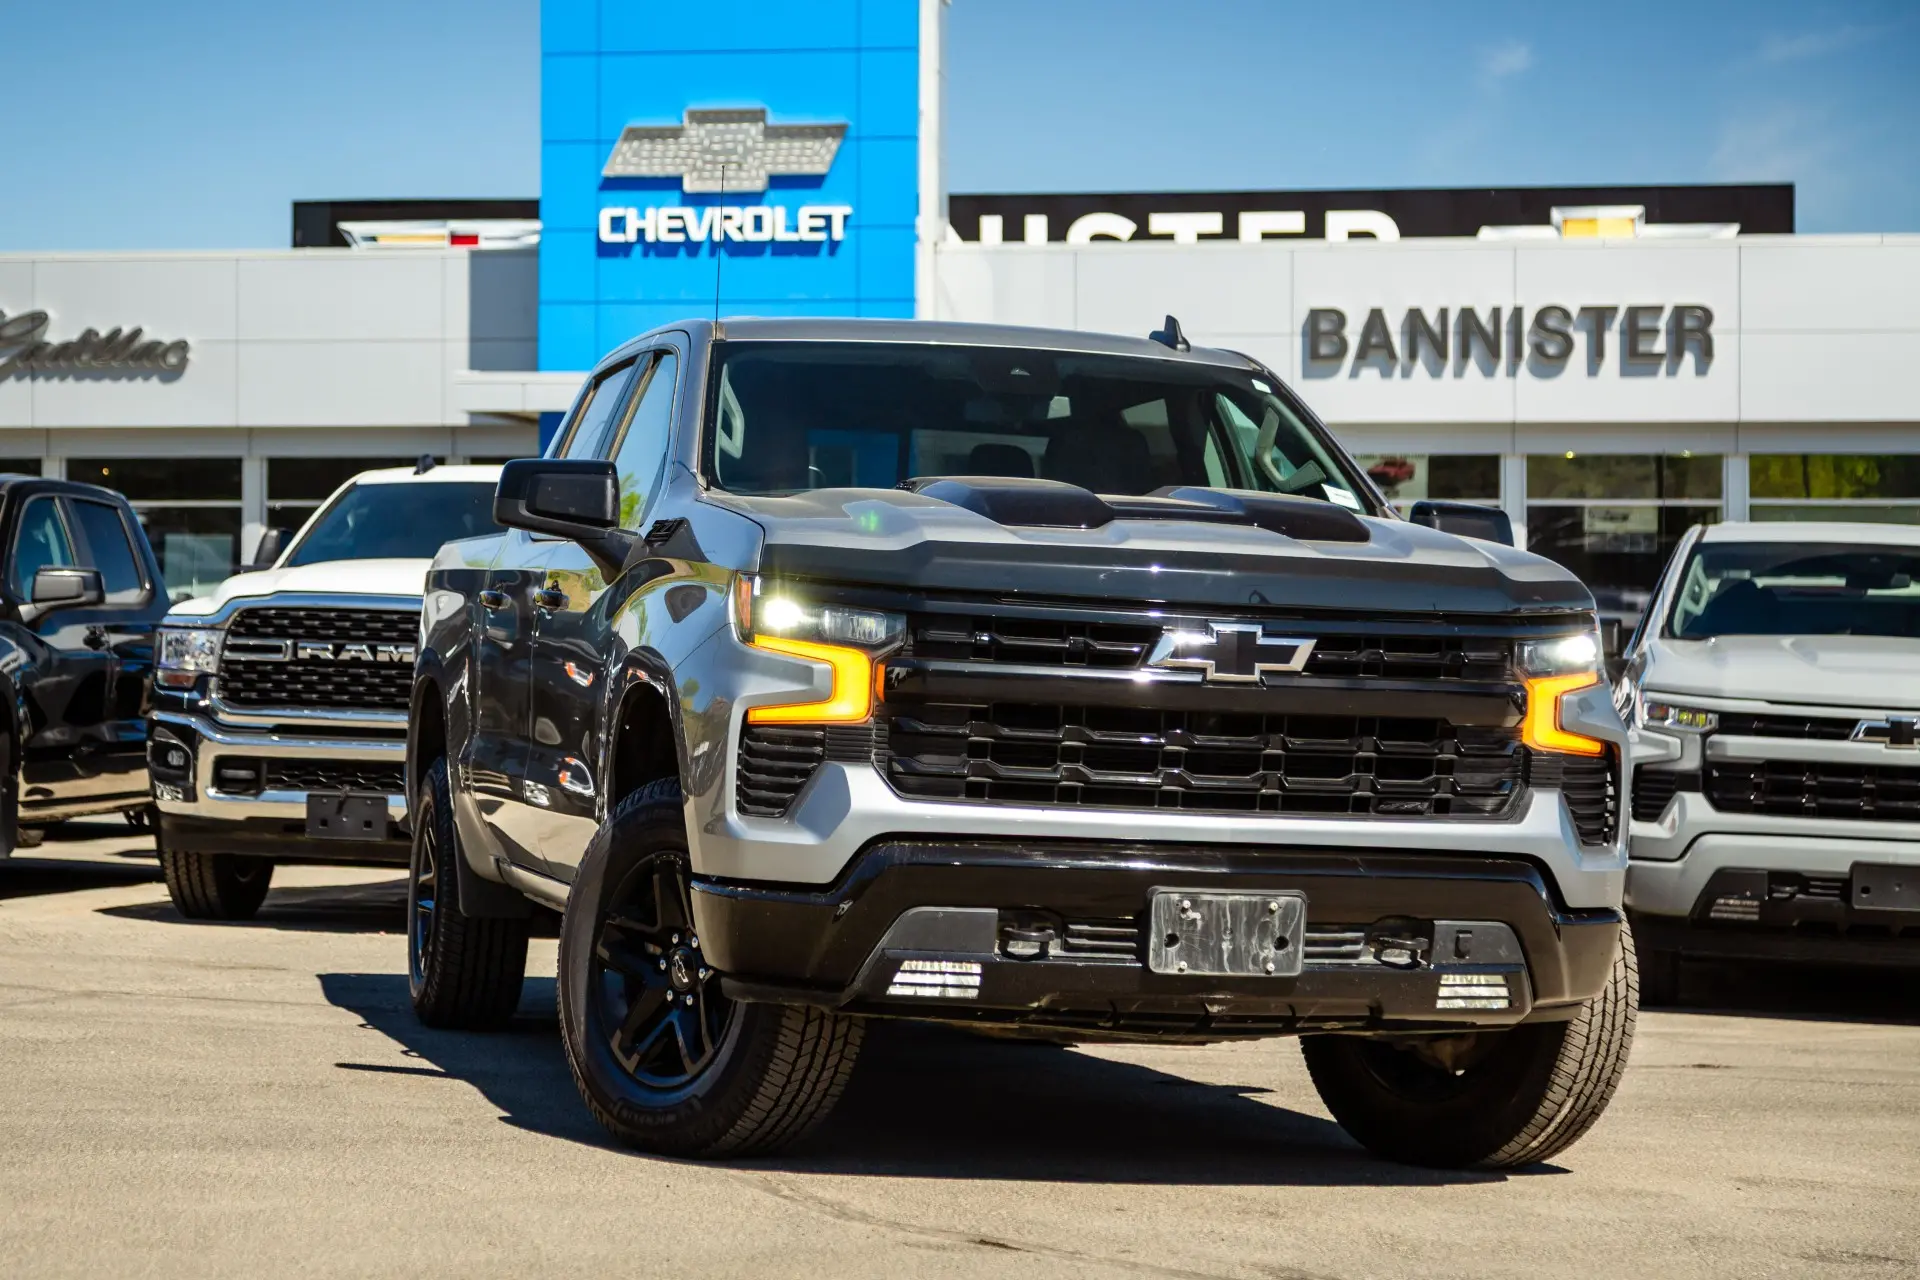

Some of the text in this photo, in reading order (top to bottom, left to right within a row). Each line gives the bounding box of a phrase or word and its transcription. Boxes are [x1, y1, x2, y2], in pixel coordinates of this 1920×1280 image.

[598, 205, 852, 242] CHEVROLET
[1307, 304, 1716, 365] BANNISTER
[297, 641, 416, 662] RAM
